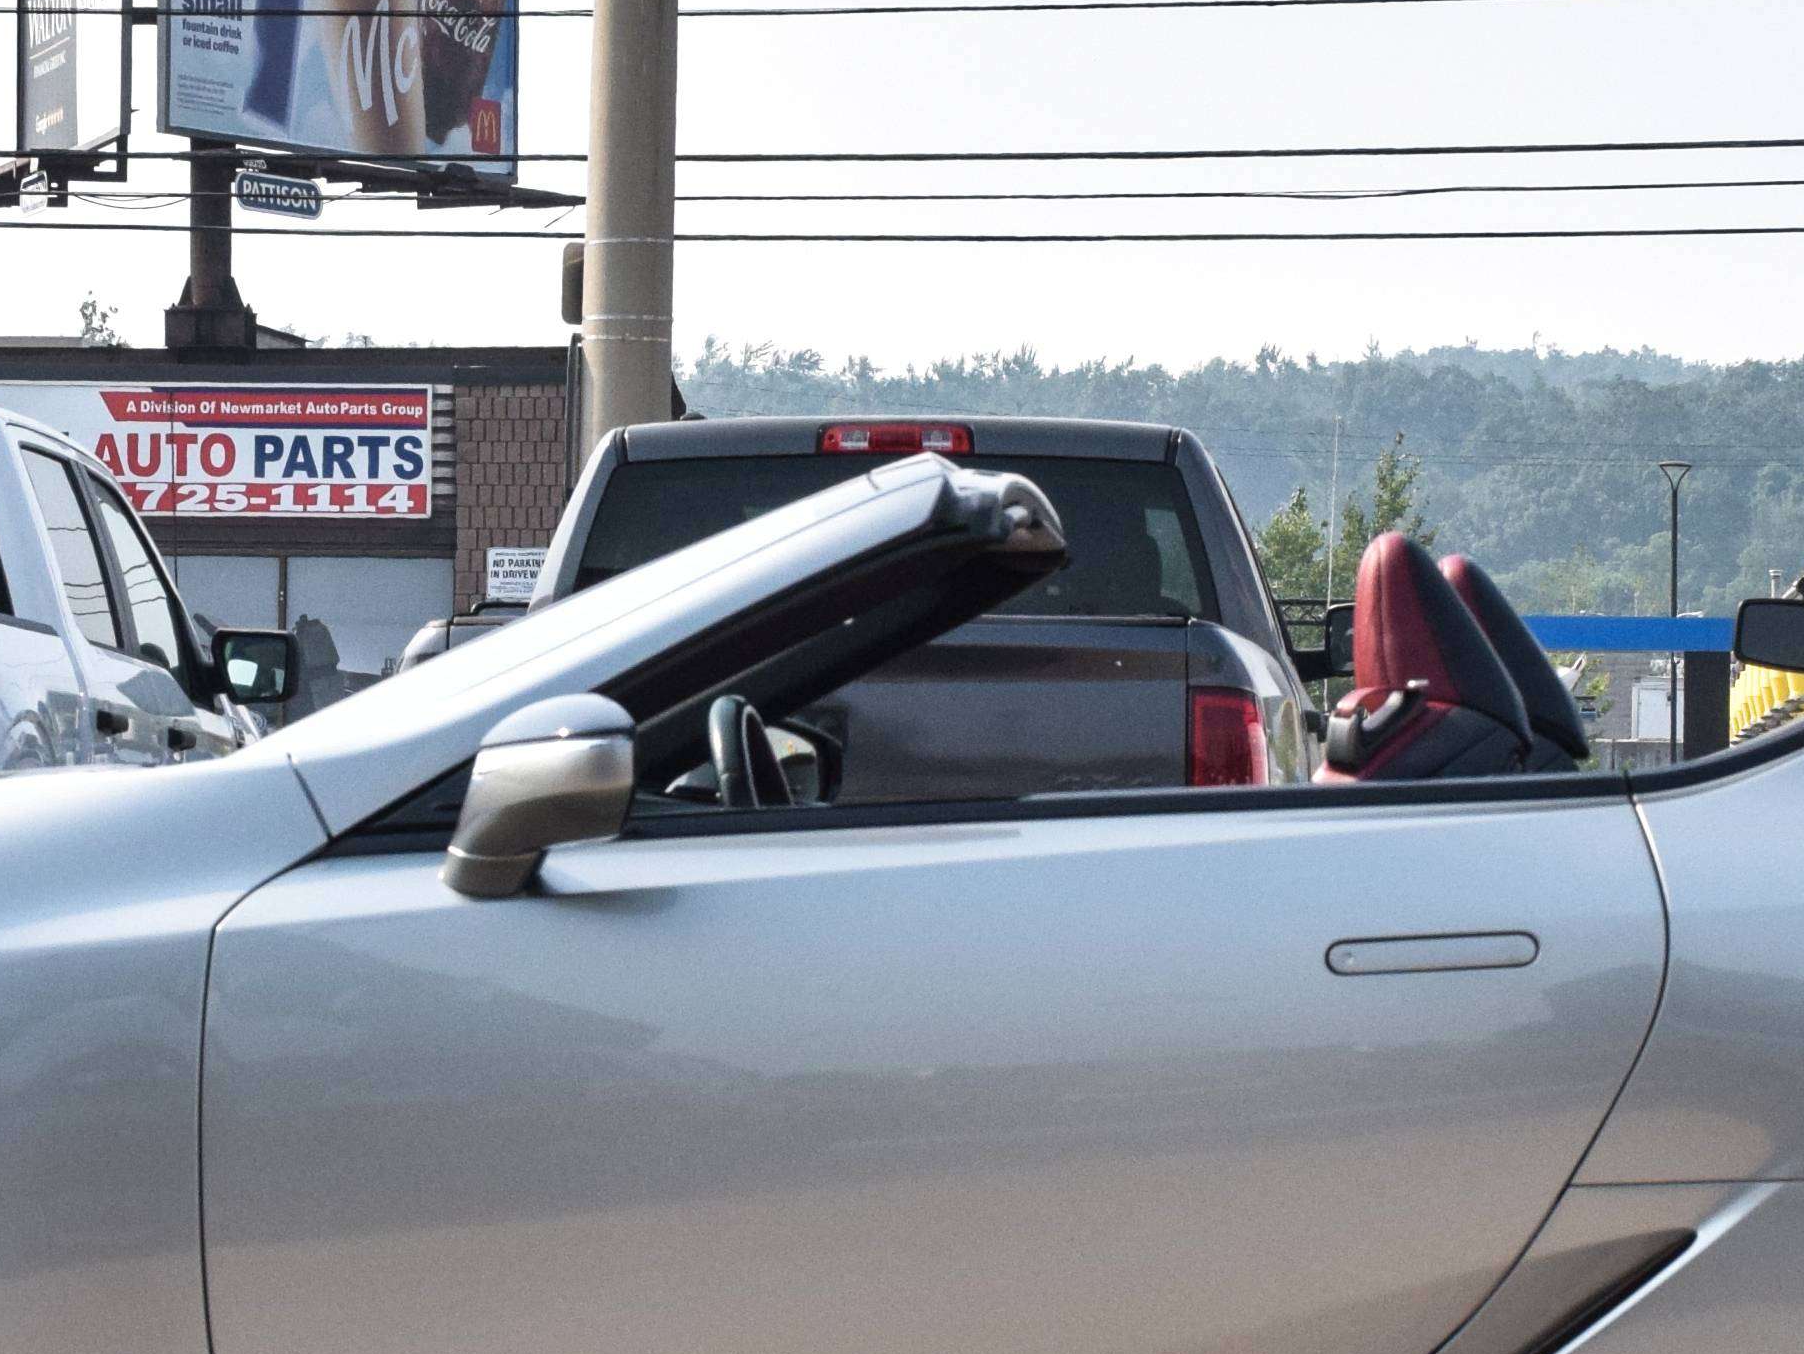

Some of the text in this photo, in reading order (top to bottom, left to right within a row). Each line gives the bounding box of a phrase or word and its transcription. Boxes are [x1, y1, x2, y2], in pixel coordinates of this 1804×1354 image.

[182, 18, 242, 39] fountain drink
[183, 36, 192, 46] or
[193, 35, 211, 50] iced
[243, 179, 317, 210] PATTISON
[126, 401, 137, 413] A
[140, 401, 195, 414] Division
[200, 401, 216, 414] Of
[221, 401, 301, 415] Newmarket
[341, 402, 377, 416] Parts
[382, 402, 423, 419] Group
[95, 433, 424, 480] AUTO PARTS
[493, 558, 546, 568] NO PARKIN
[491, 569, 538, 579] IN DRIVEW
